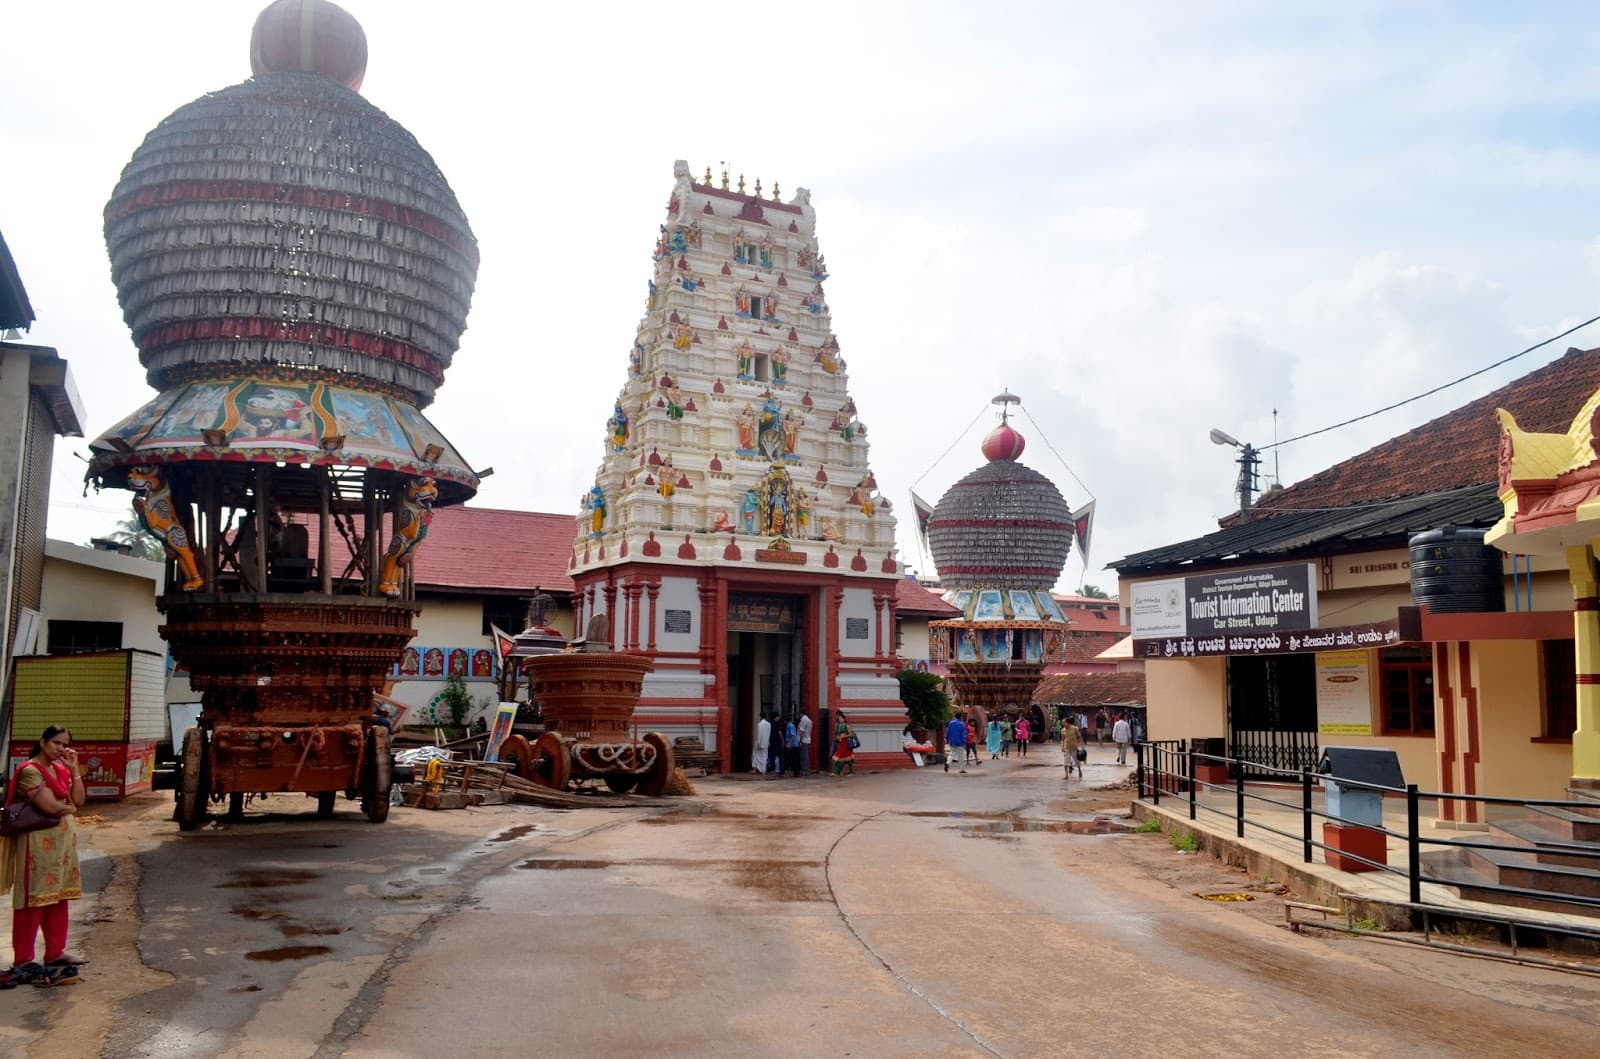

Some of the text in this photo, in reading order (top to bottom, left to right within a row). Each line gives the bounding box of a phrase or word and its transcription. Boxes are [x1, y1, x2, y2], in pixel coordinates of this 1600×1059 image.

[1350, 566, 1361, 574] SRI
[1190, 595, 1218, 619] Tourist
[1221, 591, 1270, 617] Information
[1273, 589, 1304, 613] Center
[1214, 614, 1278, 629] Car Street, Udupi
